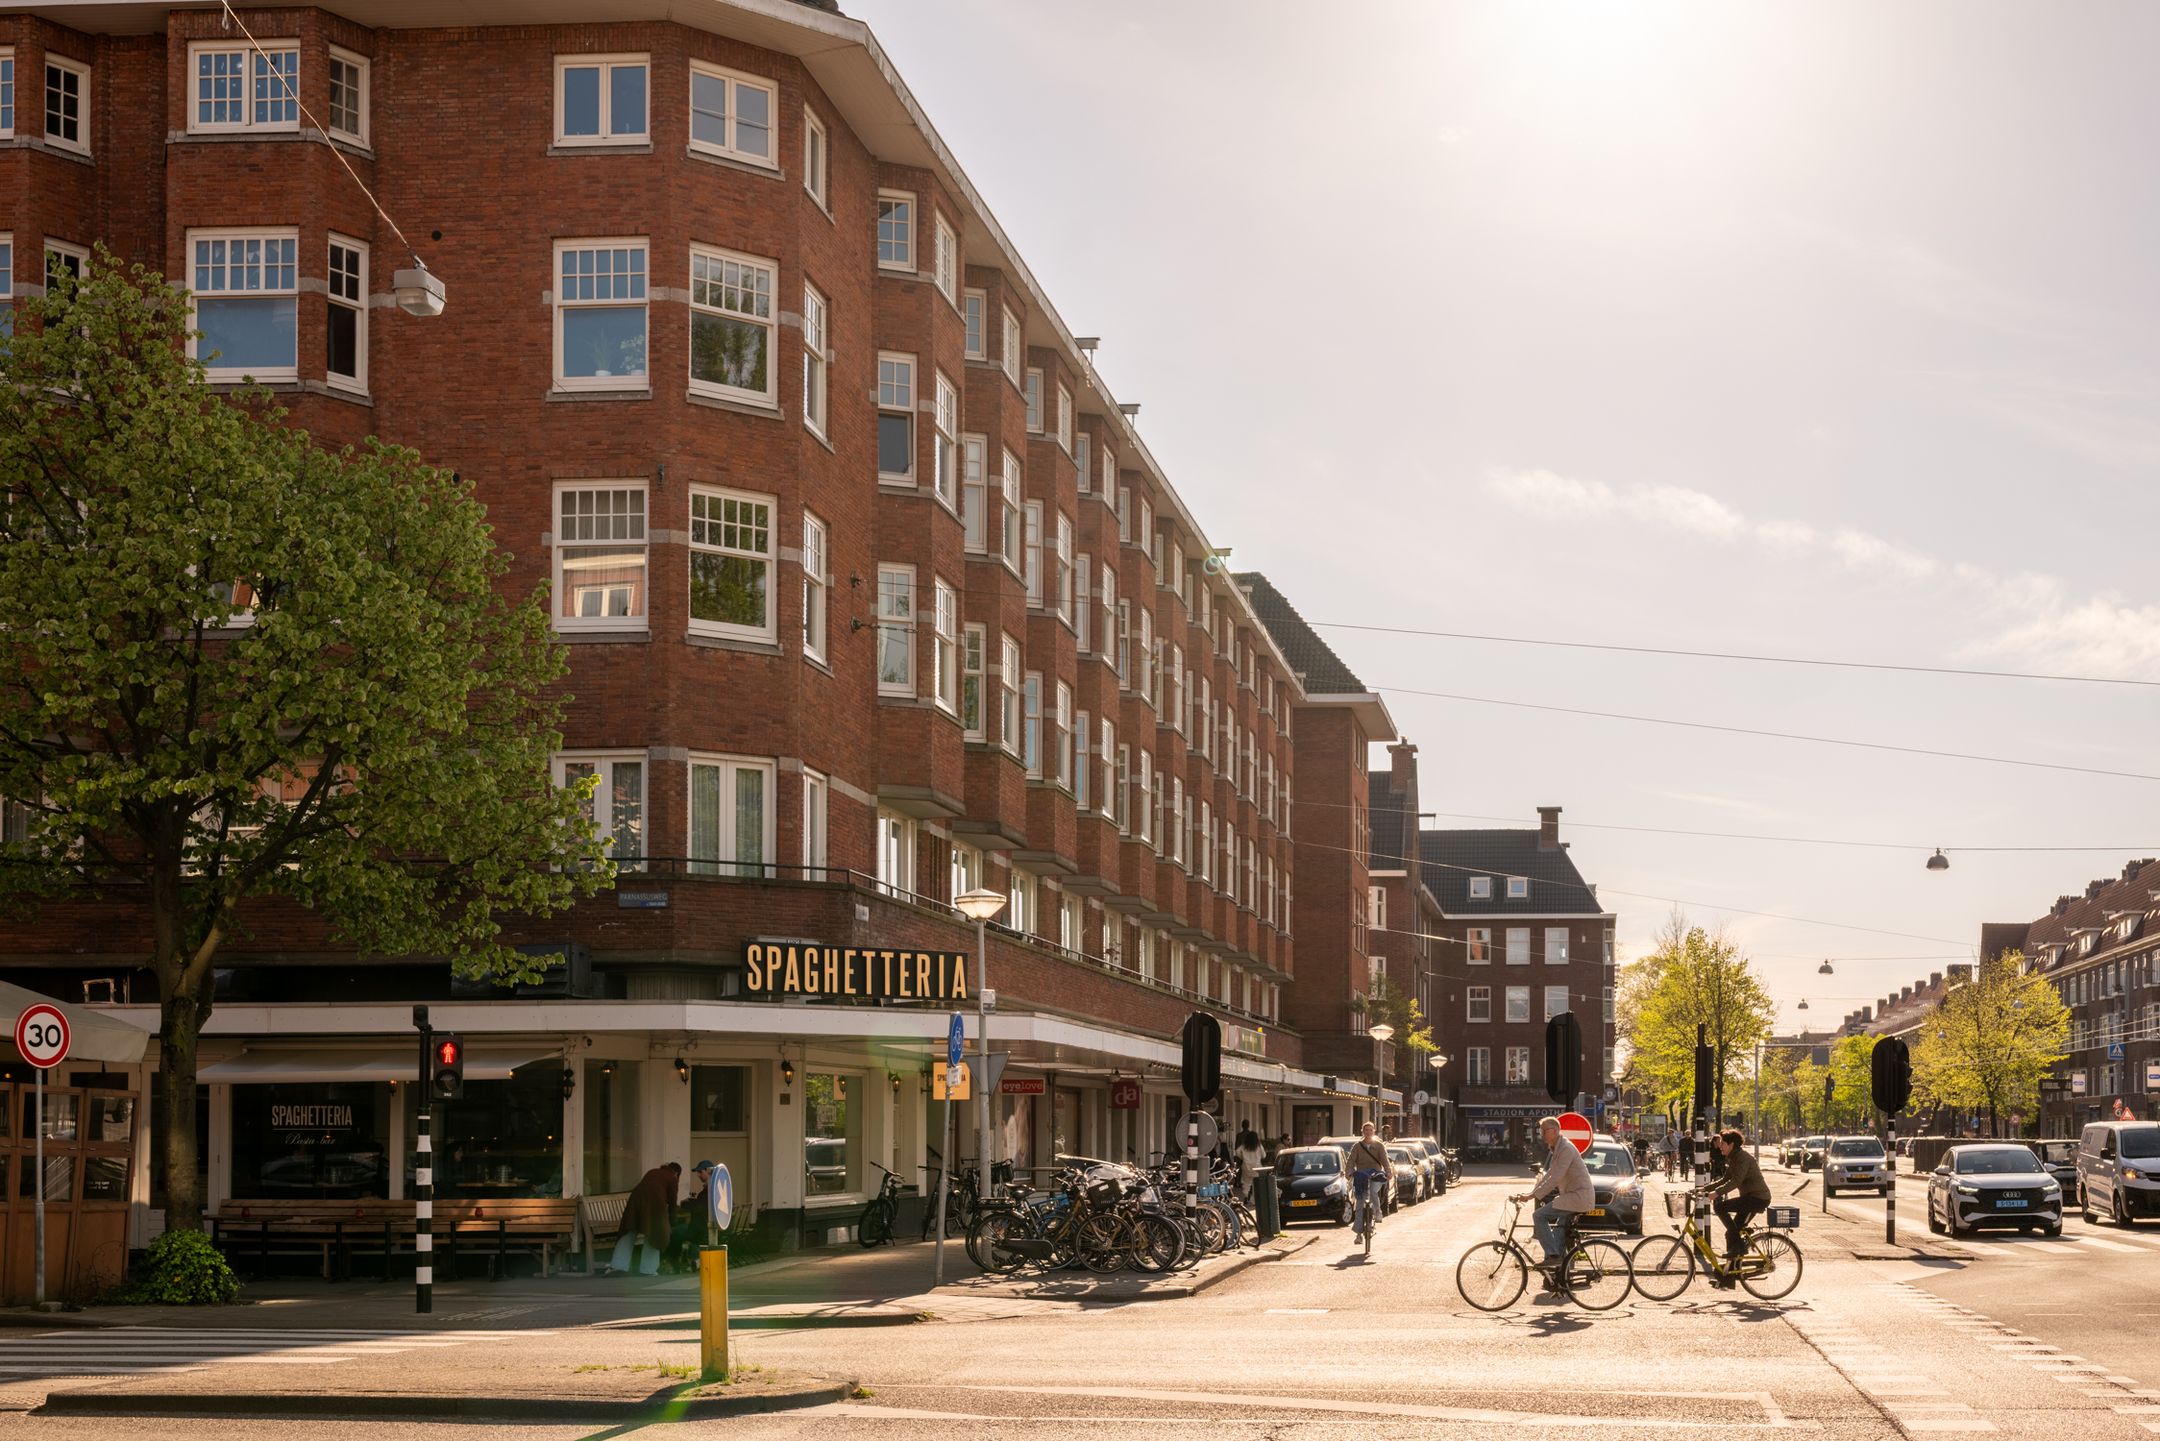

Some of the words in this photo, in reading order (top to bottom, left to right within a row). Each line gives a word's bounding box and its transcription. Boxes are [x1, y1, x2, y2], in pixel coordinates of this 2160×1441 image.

[747, 944, 967, 998] SPAGHETTERIA
[28, 1024, 61, 1048] 30
[1003, 1081, 1043, 1092] eyelove
[272, 1105, 353, 1126] SPAGHETTERIA
